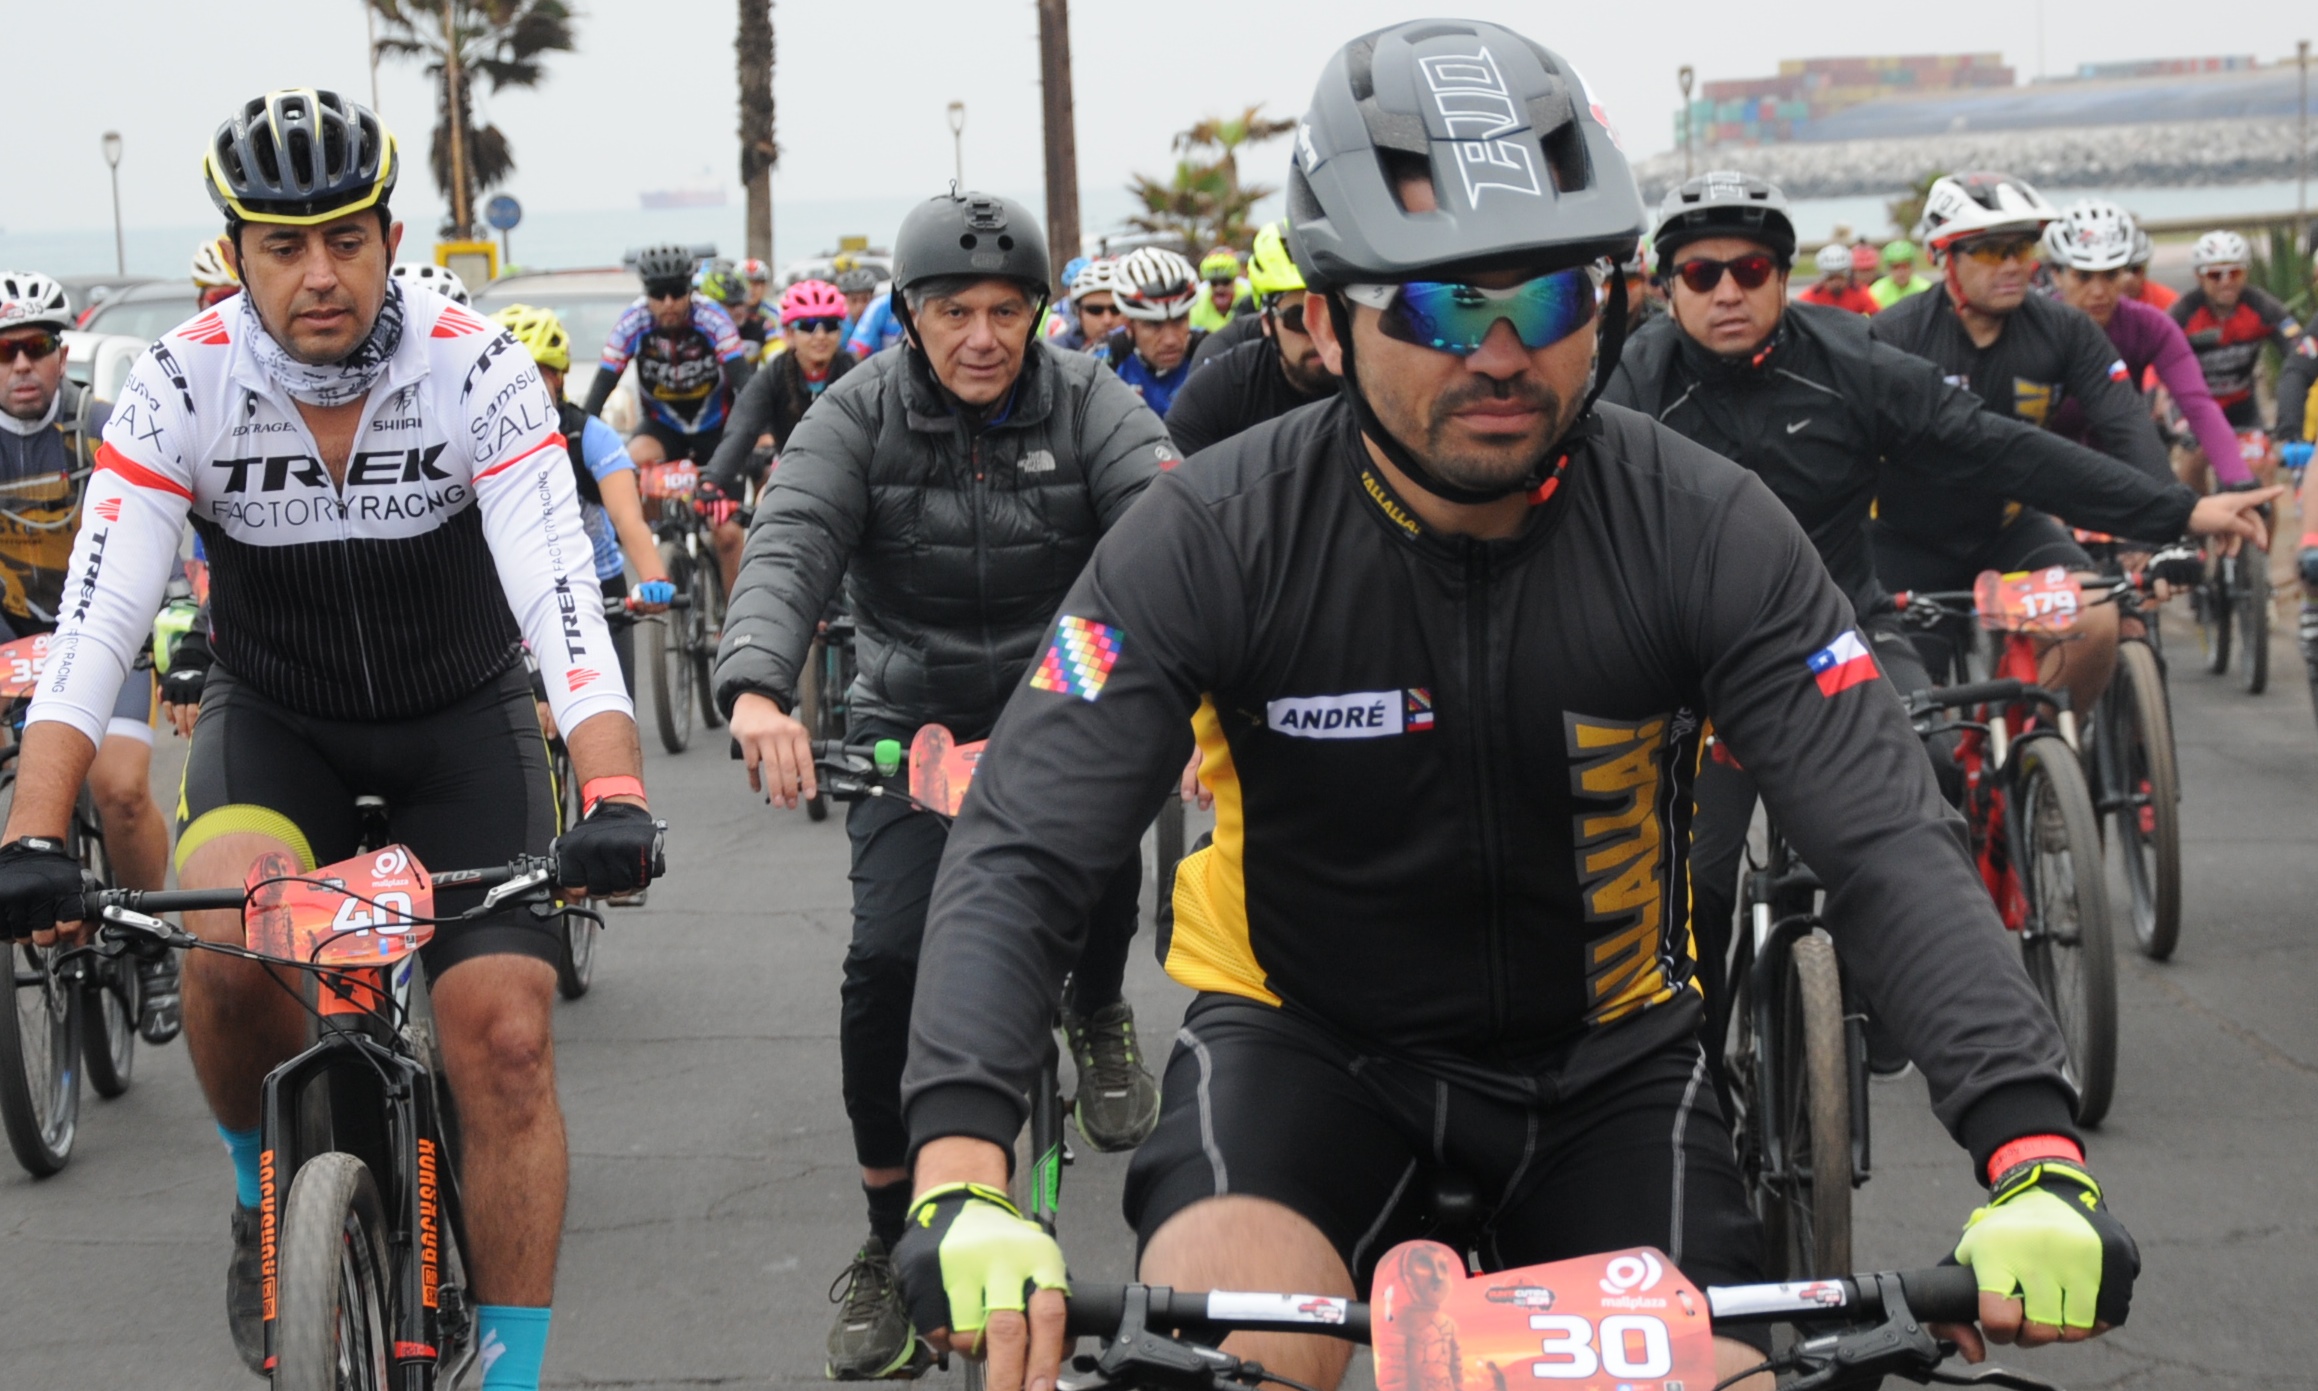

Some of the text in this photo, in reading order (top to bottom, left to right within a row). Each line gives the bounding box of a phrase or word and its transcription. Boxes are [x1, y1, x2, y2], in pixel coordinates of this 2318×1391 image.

[460, 330, 520, 405] TRE
[212, 441, 453, 493] TREK
[663, 472, 697, 490] 100
[71, 527, 109, 624] TREK
[554, 574, 587, 664] TREK
[2021, 590, 2077, 618] 179
[1279, 700, 1385, 730] ANDRÉ
[371, 878, 409, 889] mallplaza
[332, 891, 413, 937] 40
[1601, 1296, 1667, 1310] mallplaza
[1528, 1314, 1673, 1379] 30
